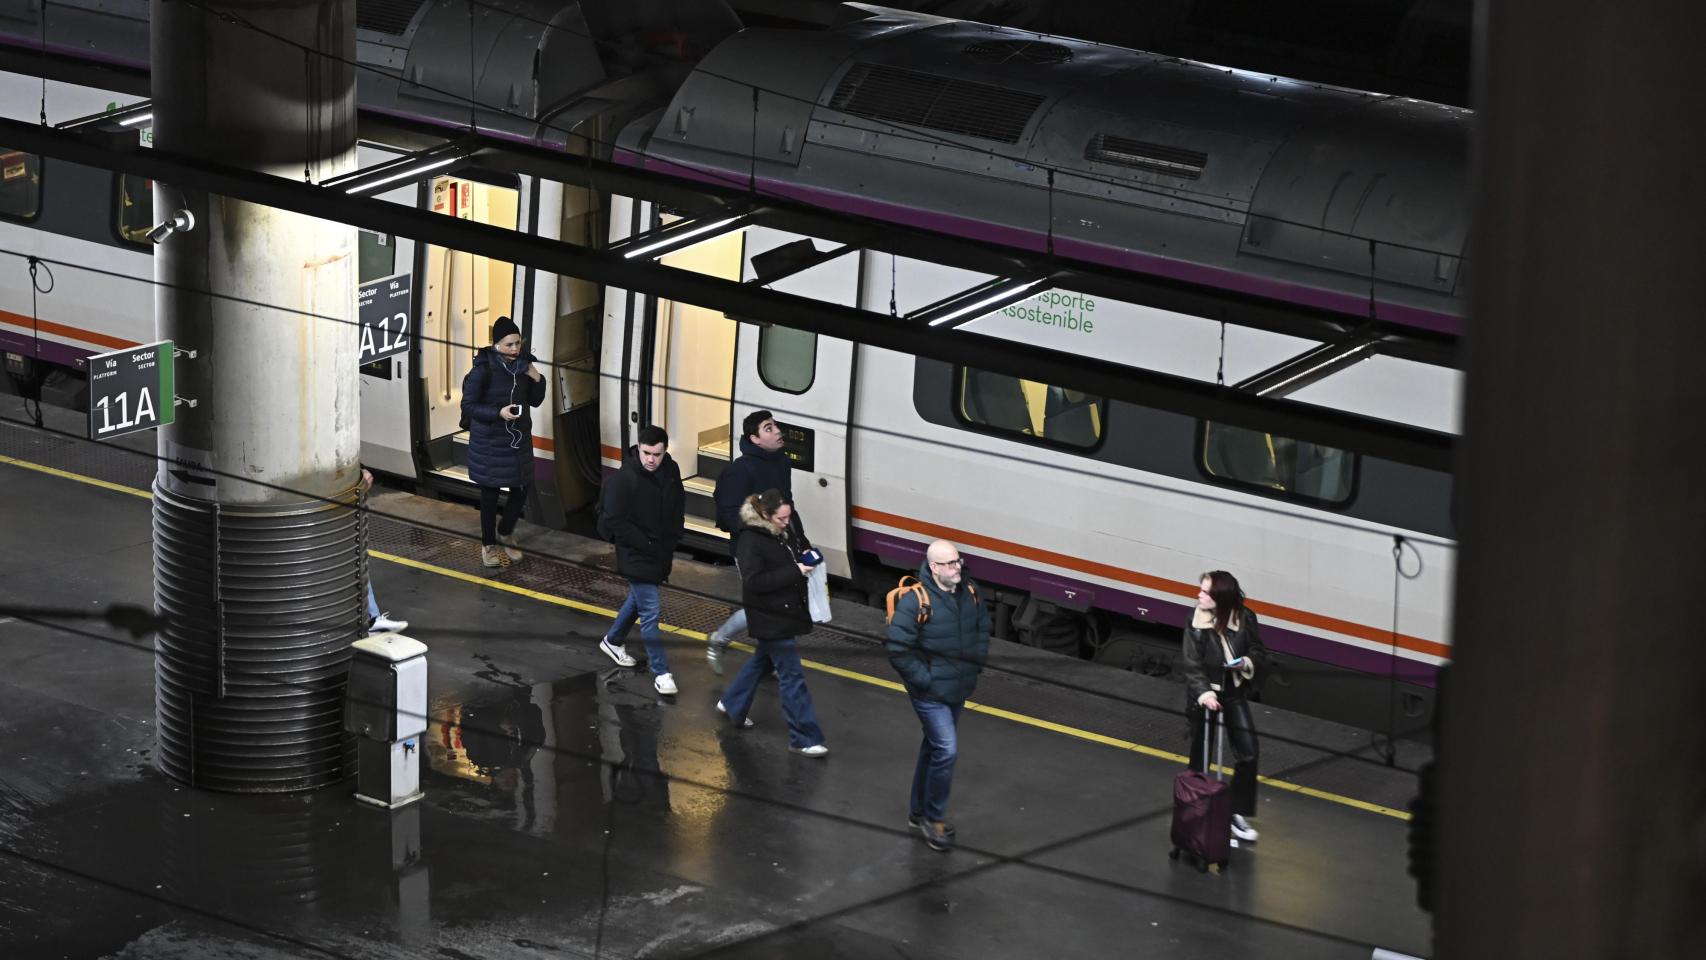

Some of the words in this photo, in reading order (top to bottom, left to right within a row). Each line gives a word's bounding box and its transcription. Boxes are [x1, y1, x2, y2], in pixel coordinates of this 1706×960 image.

[358, 288, 378, 299] Sector
[389, 281, 399, 290] Vía
[105, 359, 117, 368] Vía
[132, 351, 155, 363] Sector
[93, 370, 118, 380] PLATFORM
[96, 386, 156, 434] 11A
